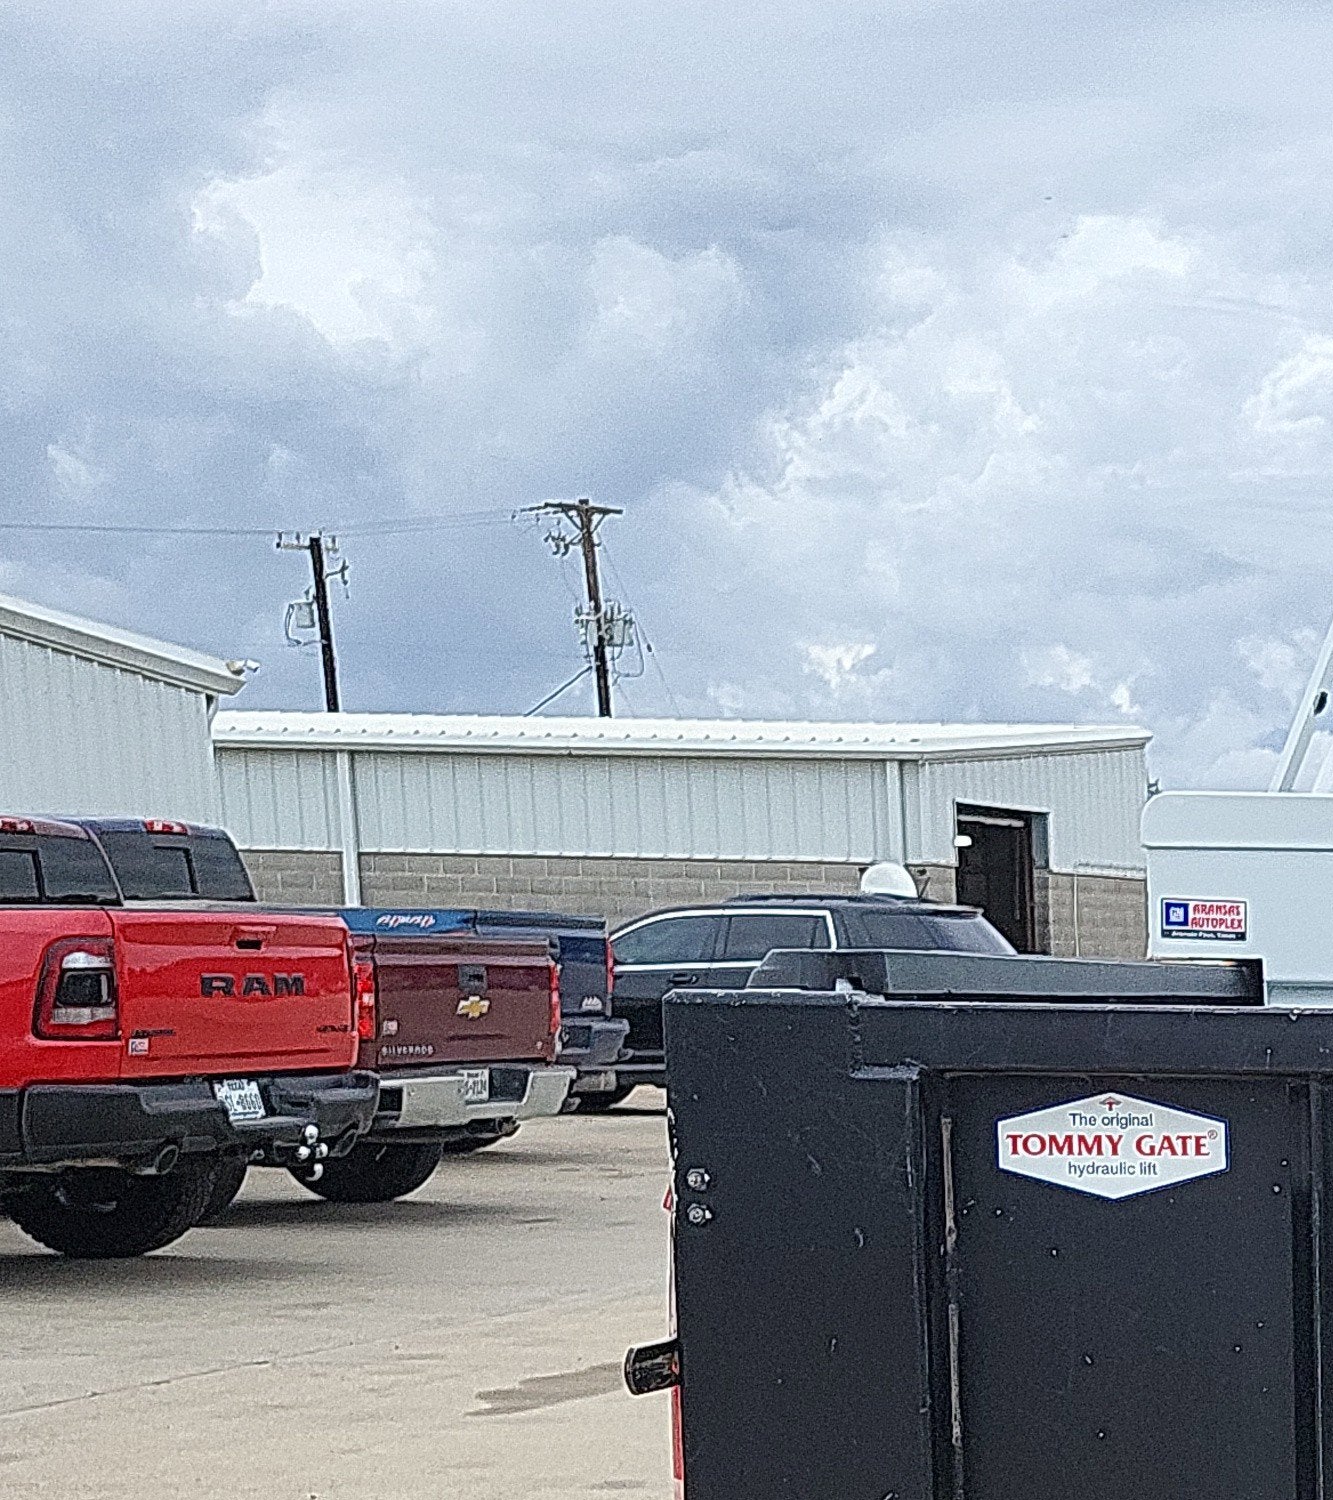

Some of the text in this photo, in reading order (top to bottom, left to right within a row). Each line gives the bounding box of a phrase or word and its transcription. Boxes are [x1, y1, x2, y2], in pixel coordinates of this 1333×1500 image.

[1193, 904, 1241, 916] ARANSAS
[1191, 917, 1243, 930] AUTOPLEX
[201, 972, 304, 997] RAM
[1069, 1112, 1153, 1129] The original
[1006, 1134, 1211, 1157] TOMMY GATE
[1068, 1162, 1158, 1178] hydraulic lift
